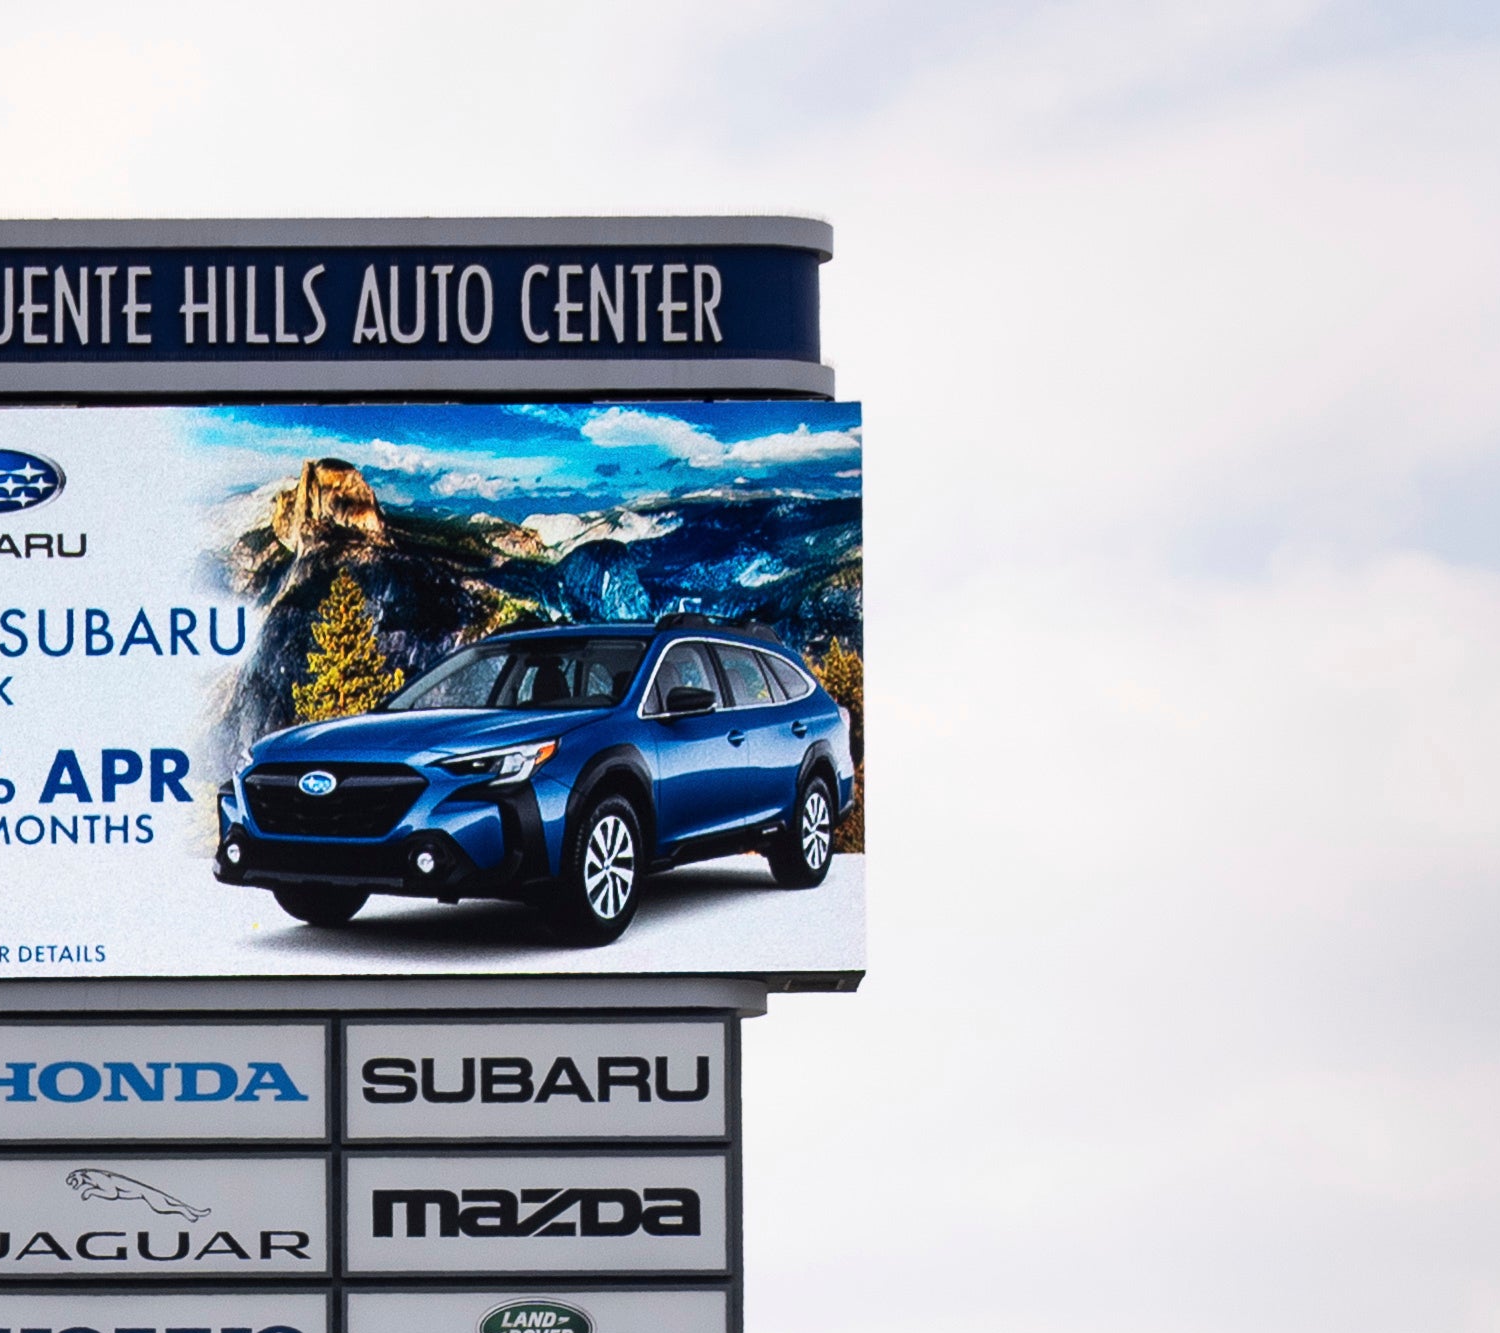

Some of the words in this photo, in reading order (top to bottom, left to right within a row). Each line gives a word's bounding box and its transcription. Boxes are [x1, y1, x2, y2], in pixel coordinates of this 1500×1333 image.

[179, 264, 327, 345] HILLS
[352, 264, 496, 345] AUTO
[521, 263, 725, 344] CENTER
[40, 747, 194, 805] APR
[17, 944, 108, 963] DETAILS
[360, 1056, 712, 1105] SUBARU
[500, 1311, 560, 1328] LAND
